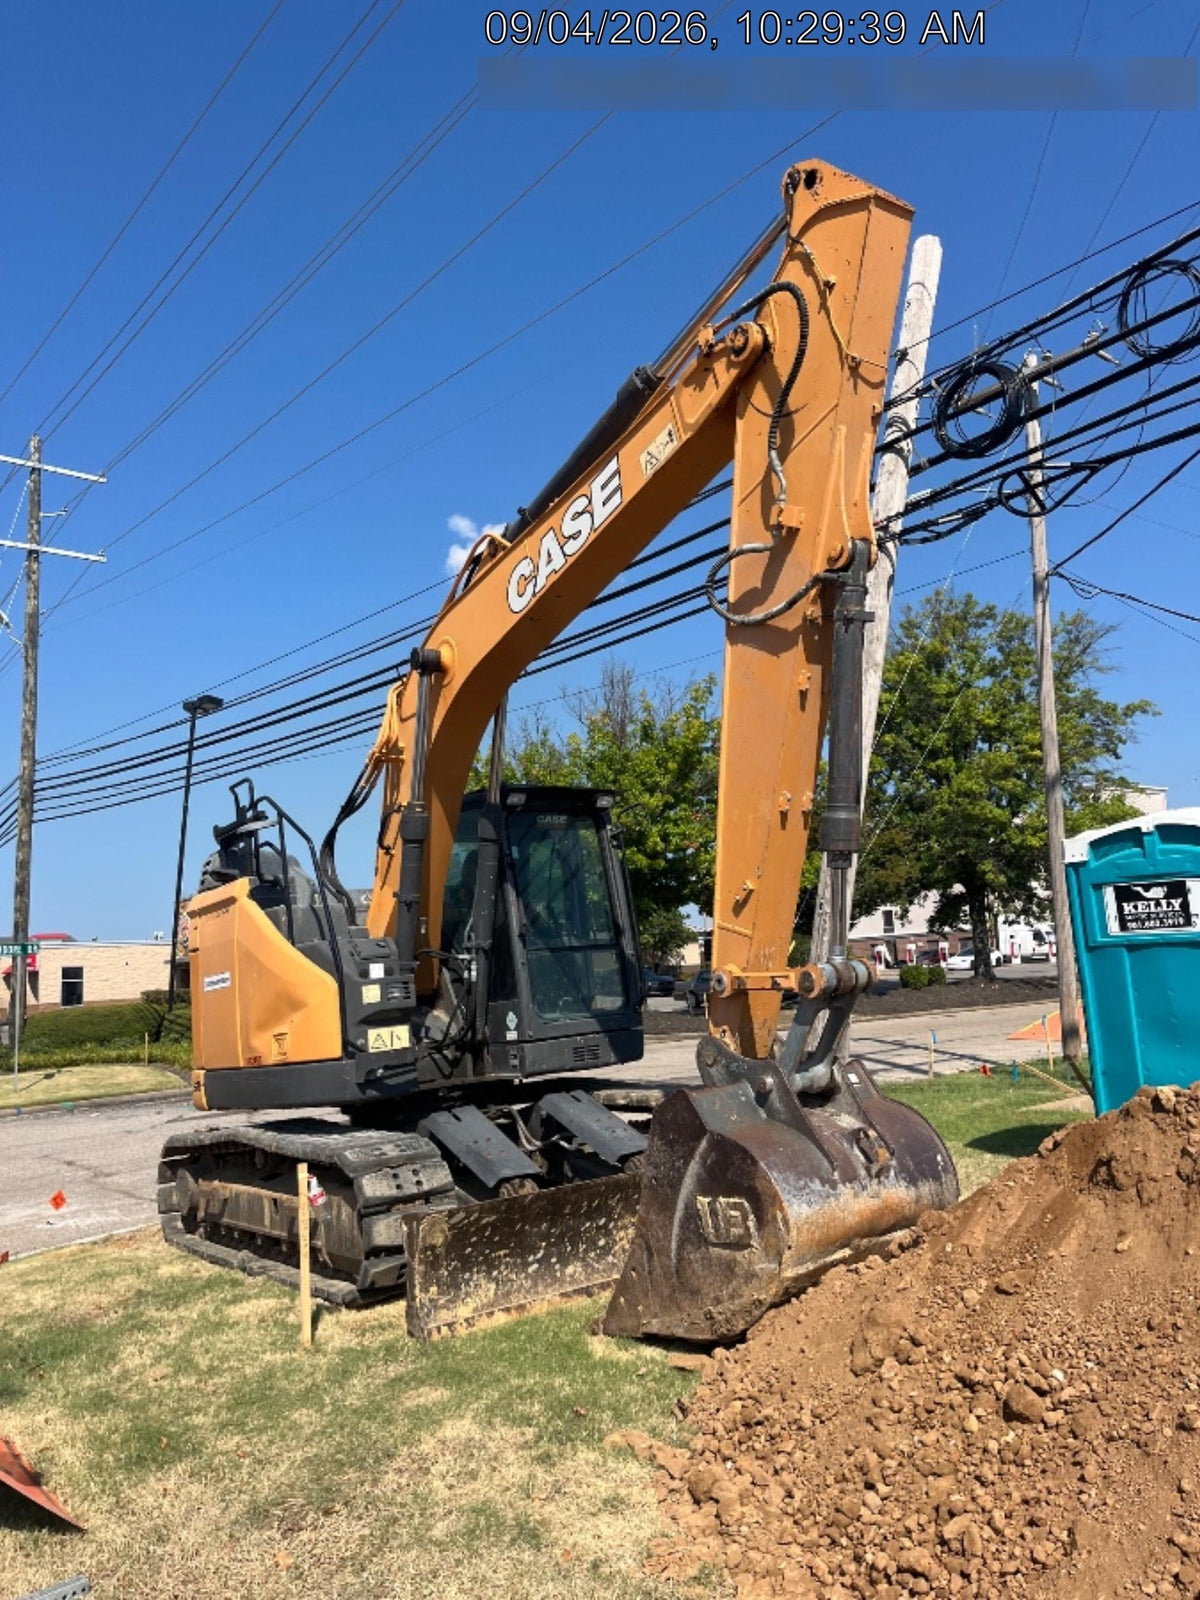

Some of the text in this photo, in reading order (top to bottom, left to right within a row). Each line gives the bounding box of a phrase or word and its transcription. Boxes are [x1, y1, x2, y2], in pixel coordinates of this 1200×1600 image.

[506, 452, 623, 614] CASE
[536, 814, 568, 825] CASE
[1122, 898, 1183, 914] KELLY
